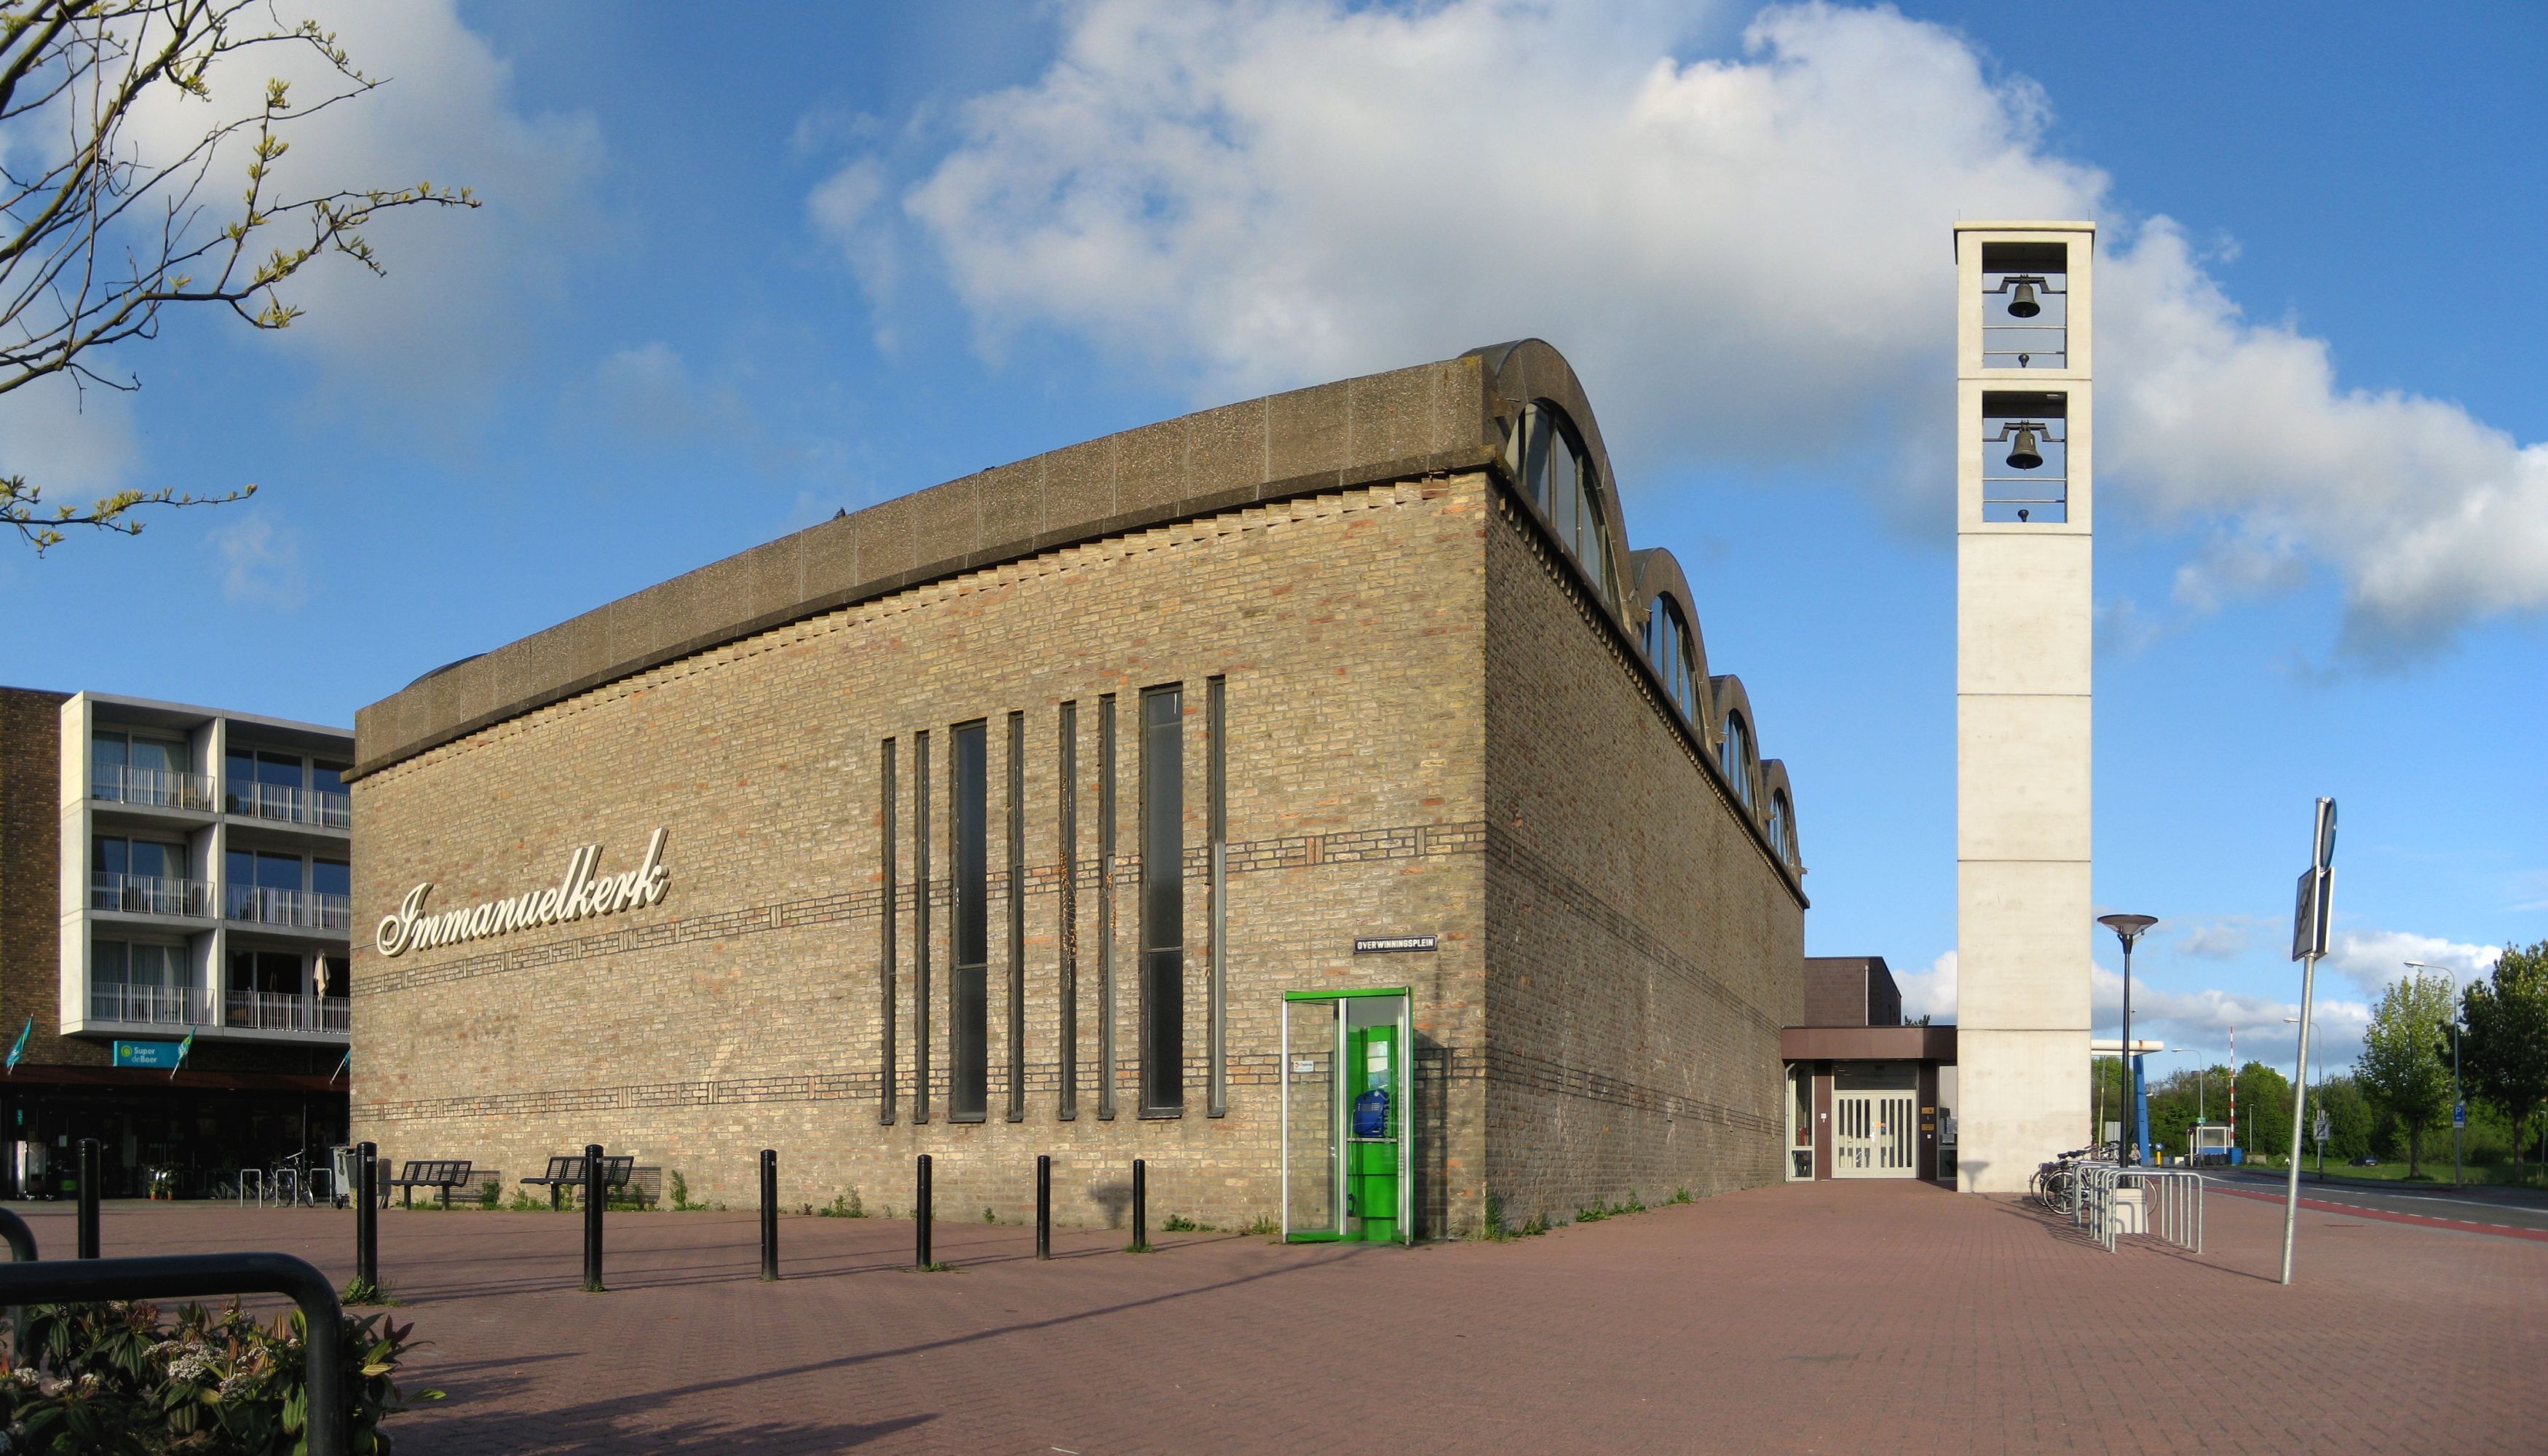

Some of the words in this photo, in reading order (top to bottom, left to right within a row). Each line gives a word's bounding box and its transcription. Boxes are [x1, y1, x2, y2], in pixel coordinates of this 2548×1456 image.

[376, 827, 668, 957] Immanuelkerk
[1357, 938, 1433, 949] OVERWINNINGSPLEIN
[134, 1047, 155, 1055] Super
